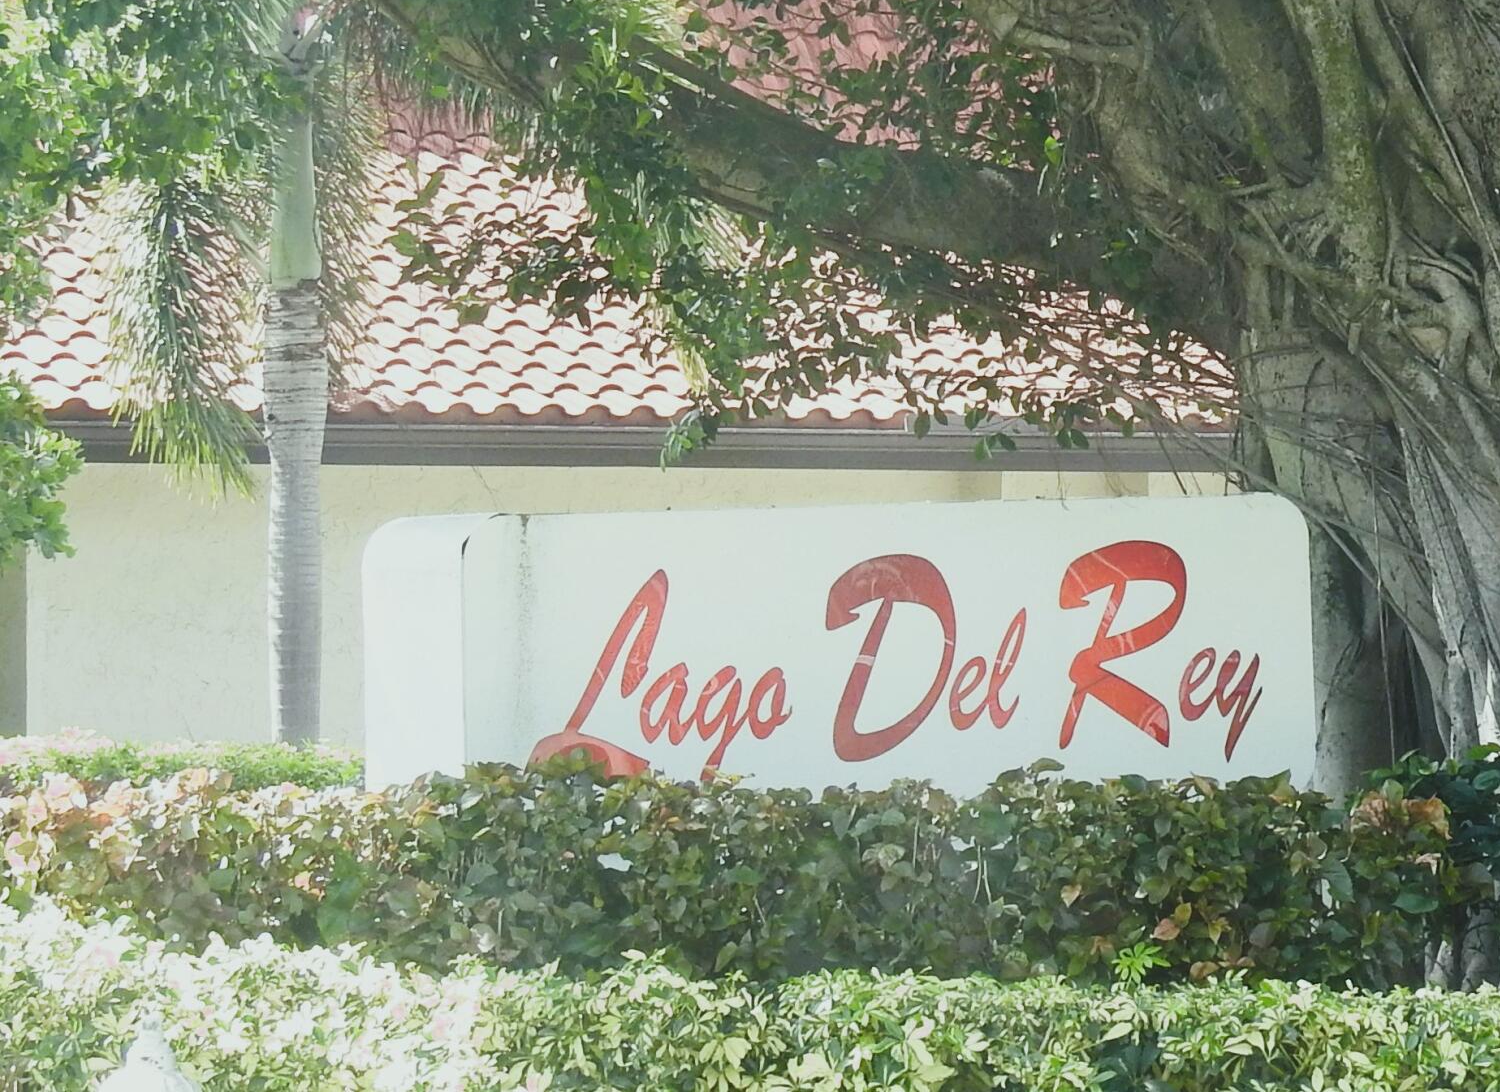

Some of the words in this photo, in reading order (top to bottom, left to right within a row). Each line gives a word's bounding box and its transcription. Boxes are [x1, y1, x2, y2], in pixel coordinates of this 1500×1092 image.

[529, 568, 792, 780] Lago
[826, 553, 1027, 761] Del
[1060, 540, 1261, 762] Rey
